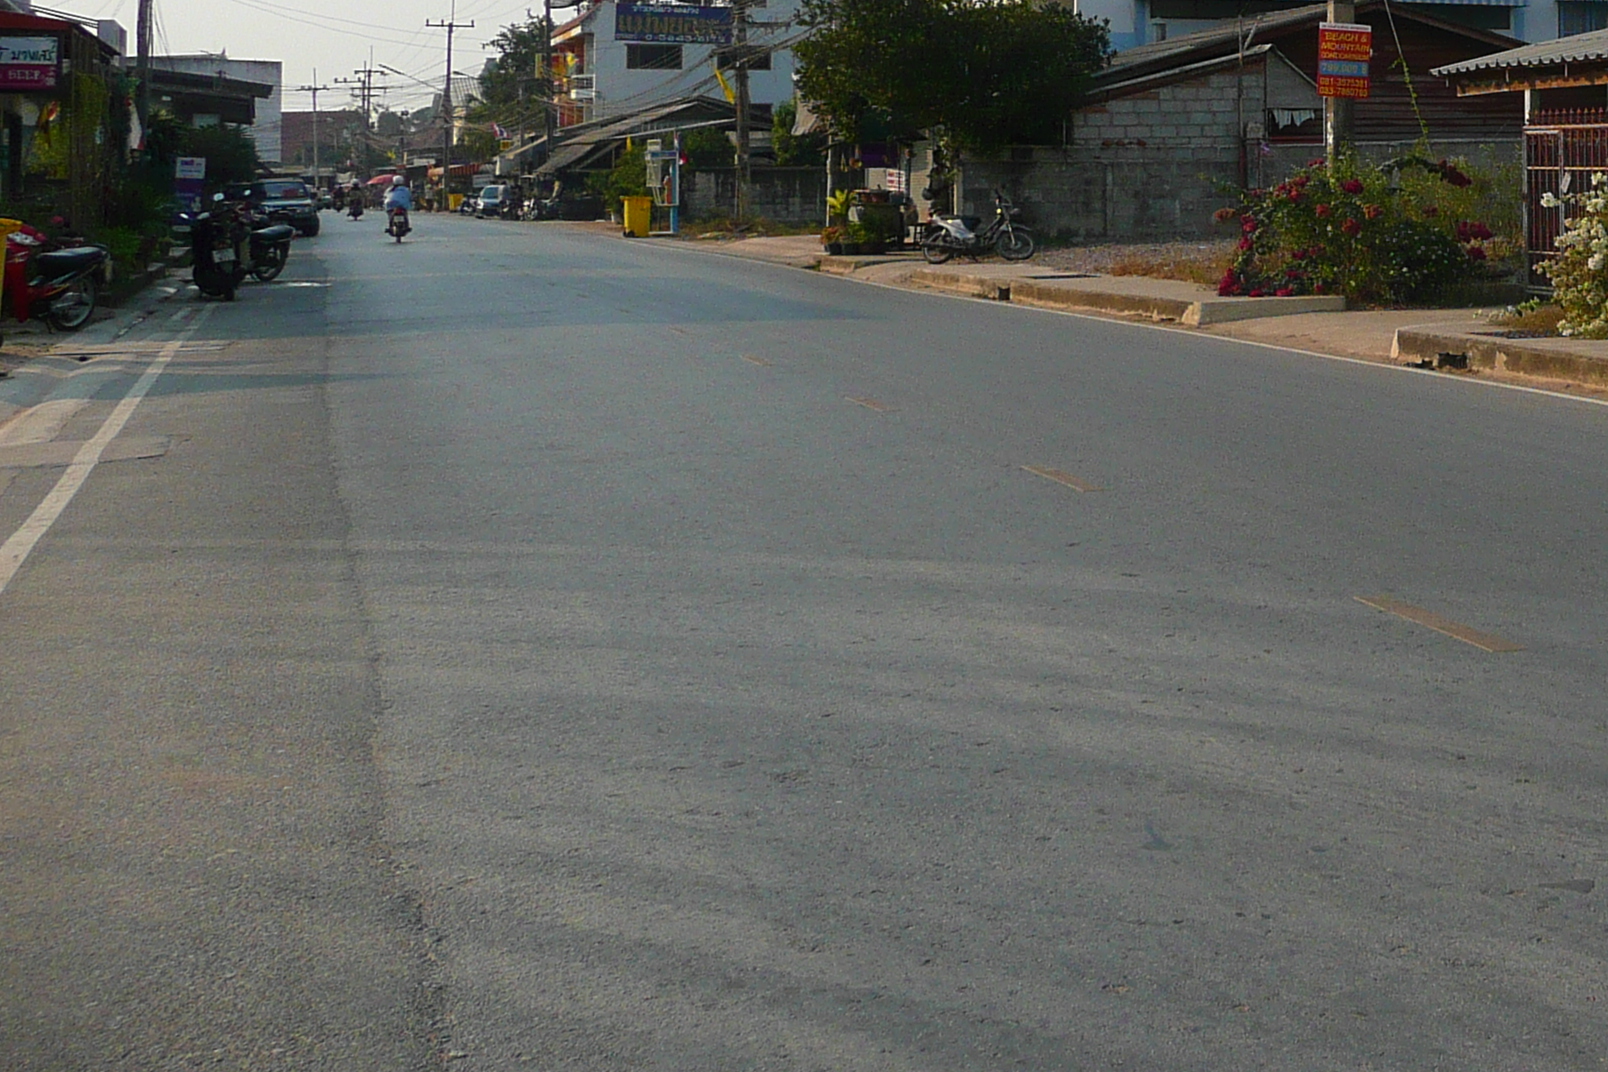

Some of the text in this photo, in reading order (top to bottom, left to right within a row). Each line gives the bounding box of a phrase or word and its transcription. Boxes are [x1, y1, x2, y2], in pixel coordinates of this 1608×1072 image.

[1325, 32, 1368, 43] BEACH &
[1321, 42, 1370, 52] MOUNTAIN
